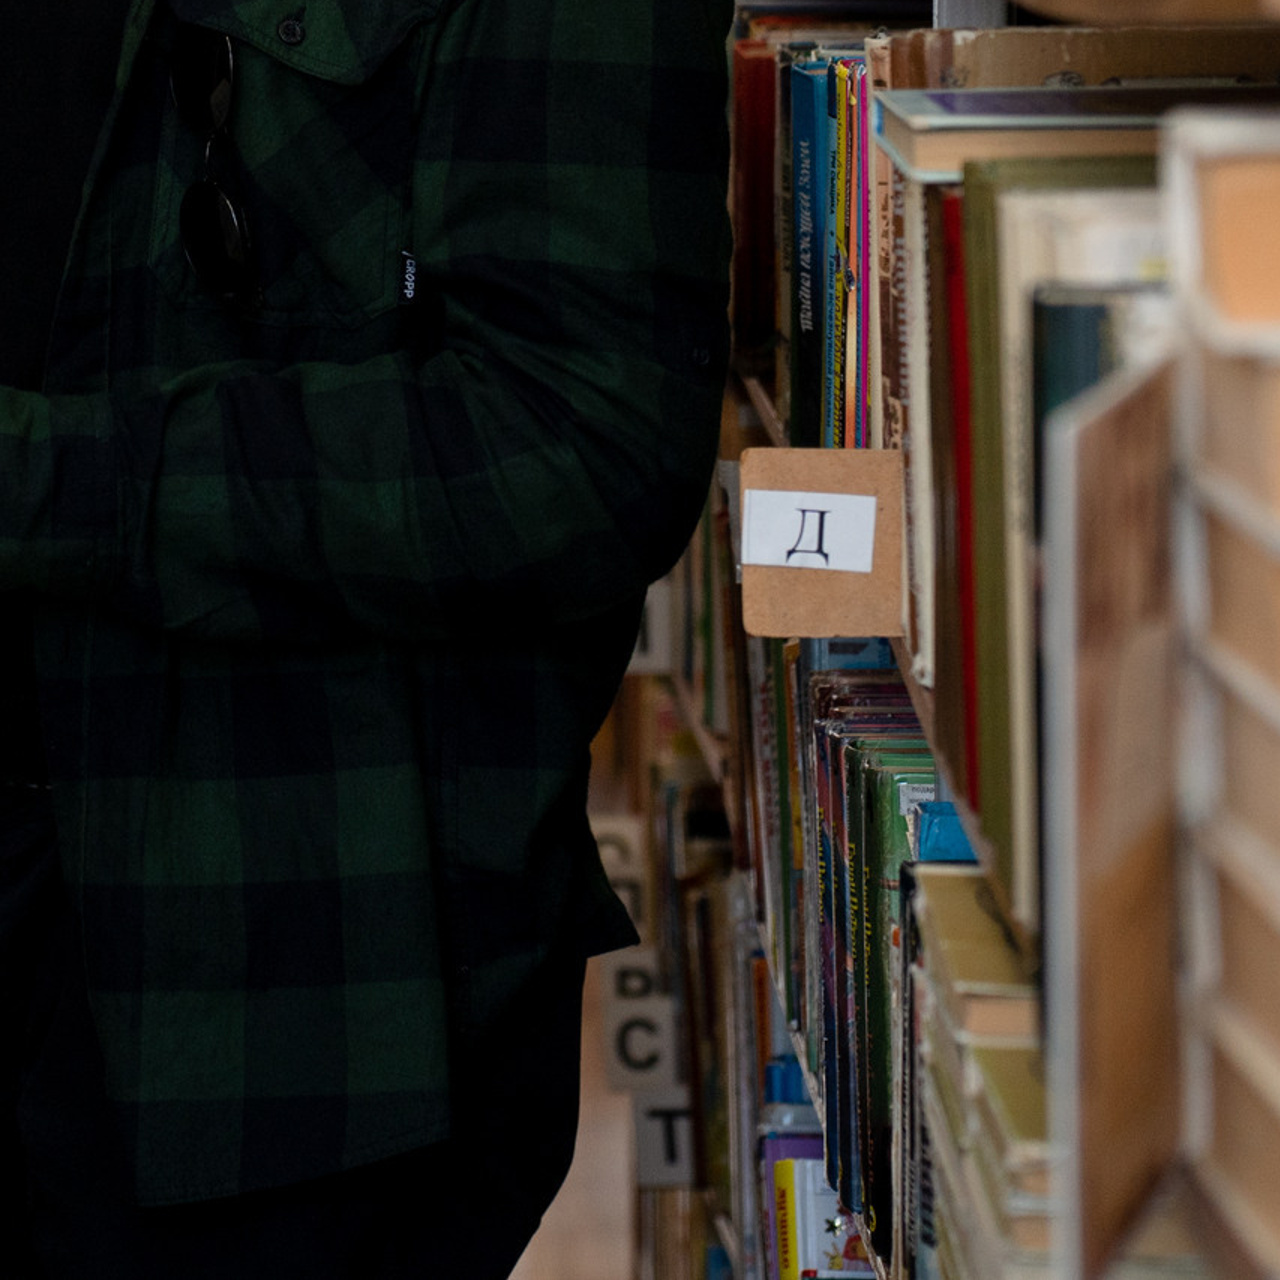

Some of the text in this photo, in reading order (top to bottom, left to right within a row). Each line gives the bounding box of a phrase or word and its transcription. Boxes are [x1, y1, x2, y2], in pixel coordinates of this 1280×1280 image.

[785, 508, 831, 567] Д
[613, 1019, 659, 1071] С
[646, 1106, 691, 1167] Т
